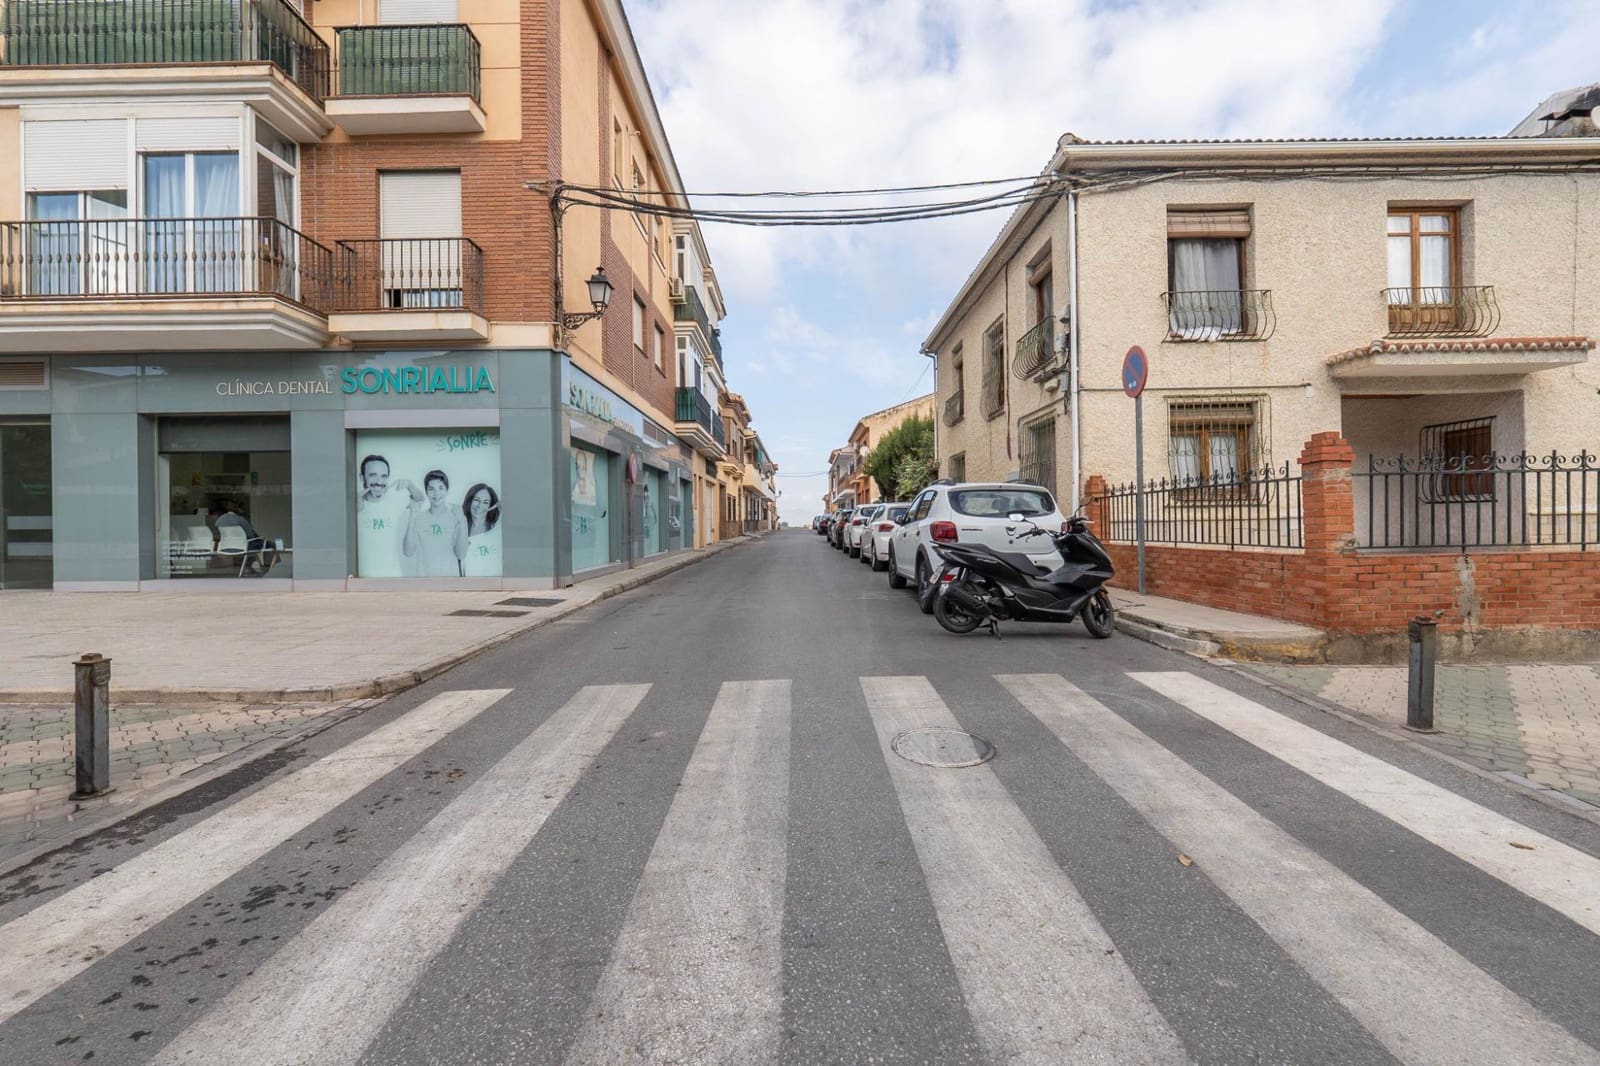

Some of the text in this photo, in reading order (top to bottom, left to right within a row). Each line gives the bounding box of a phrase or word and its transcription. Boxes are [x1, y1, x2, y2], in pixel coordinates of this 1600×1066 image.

[215, 378, 333, 396] CLÍNICA DENTAL
[340, 366, 496, 395] SONRIALIA
[432, 524, 443, 535] TA
[479, 545, 489, 557] TA
